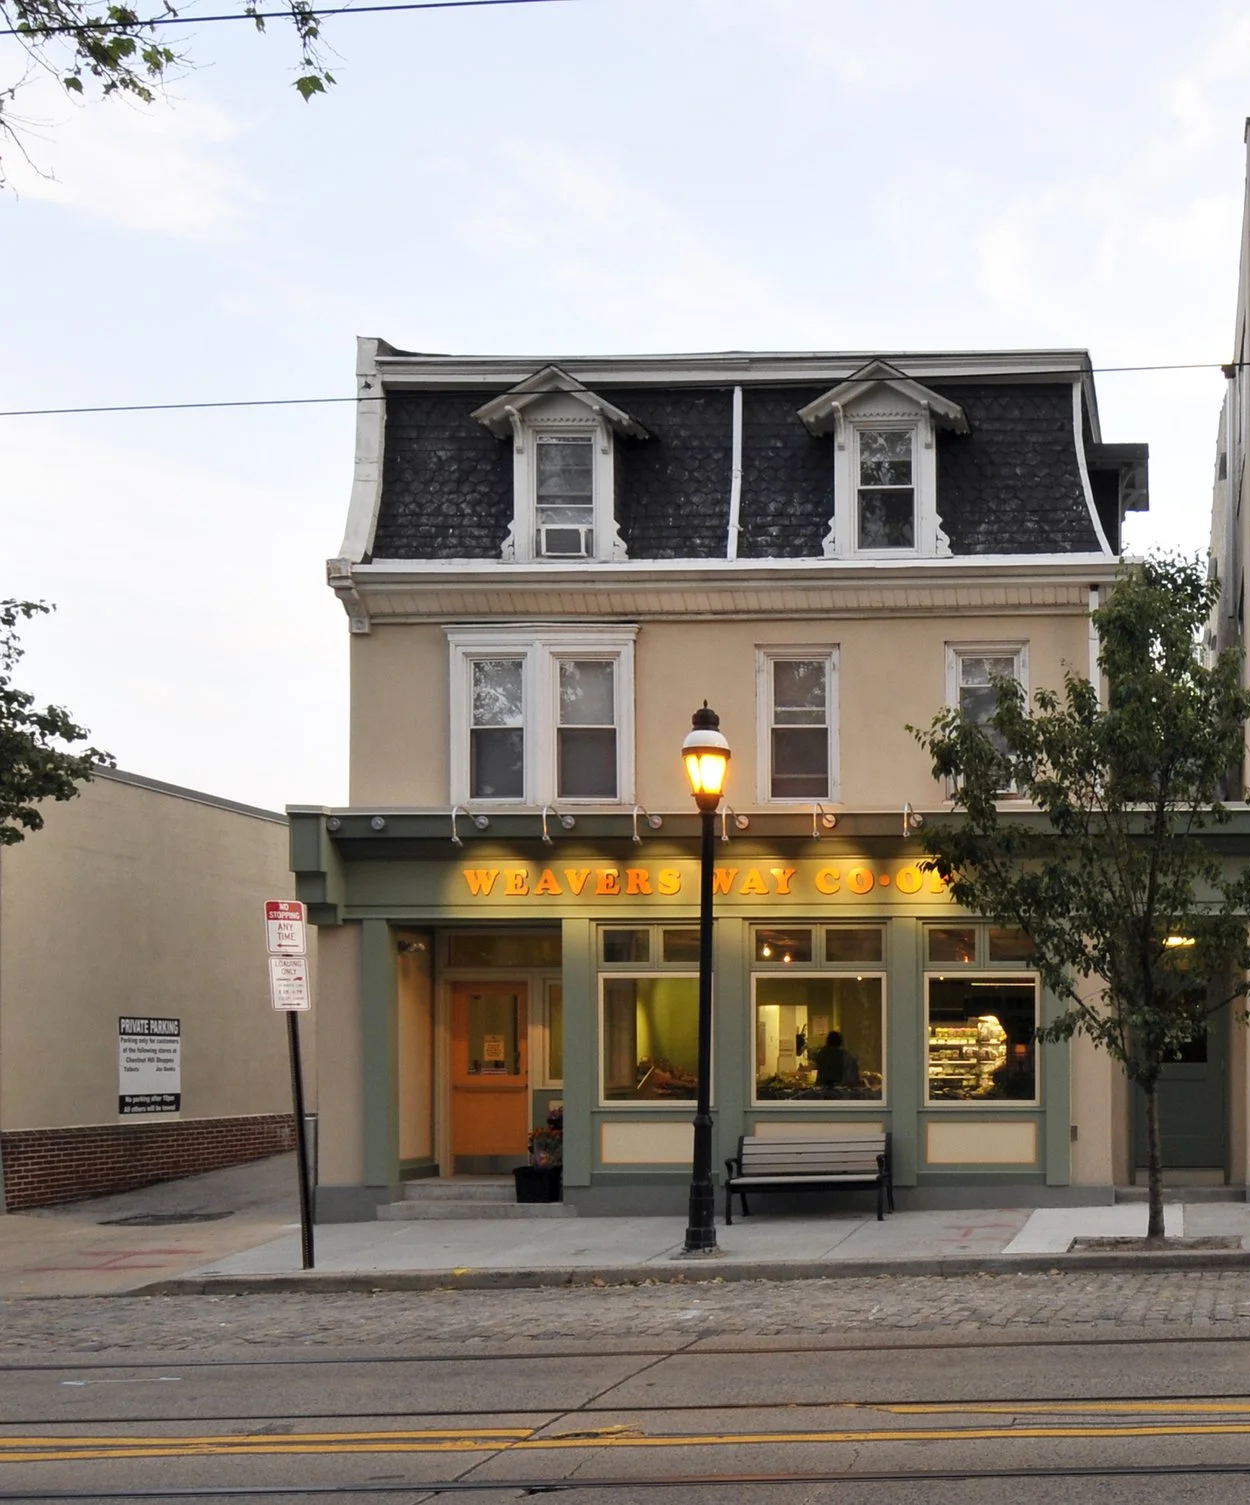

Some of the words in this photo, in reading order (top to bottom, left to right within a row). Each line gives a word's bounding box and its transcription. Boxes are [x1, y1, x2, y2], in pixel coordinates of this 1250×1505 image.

[463, 868, 683, 896] WEAVERS
[713, 867, 796, 894] WAY
[279, 903, 289, 911] NO
[268, 911, 300, 919] STOPPING
[277, 922, 293, 931] ANY
[277, 932, 296, 941] TIME
[121, 1019, 149, 1033] PRIVATE
[150, 1020, 178, 1034] PARKING
